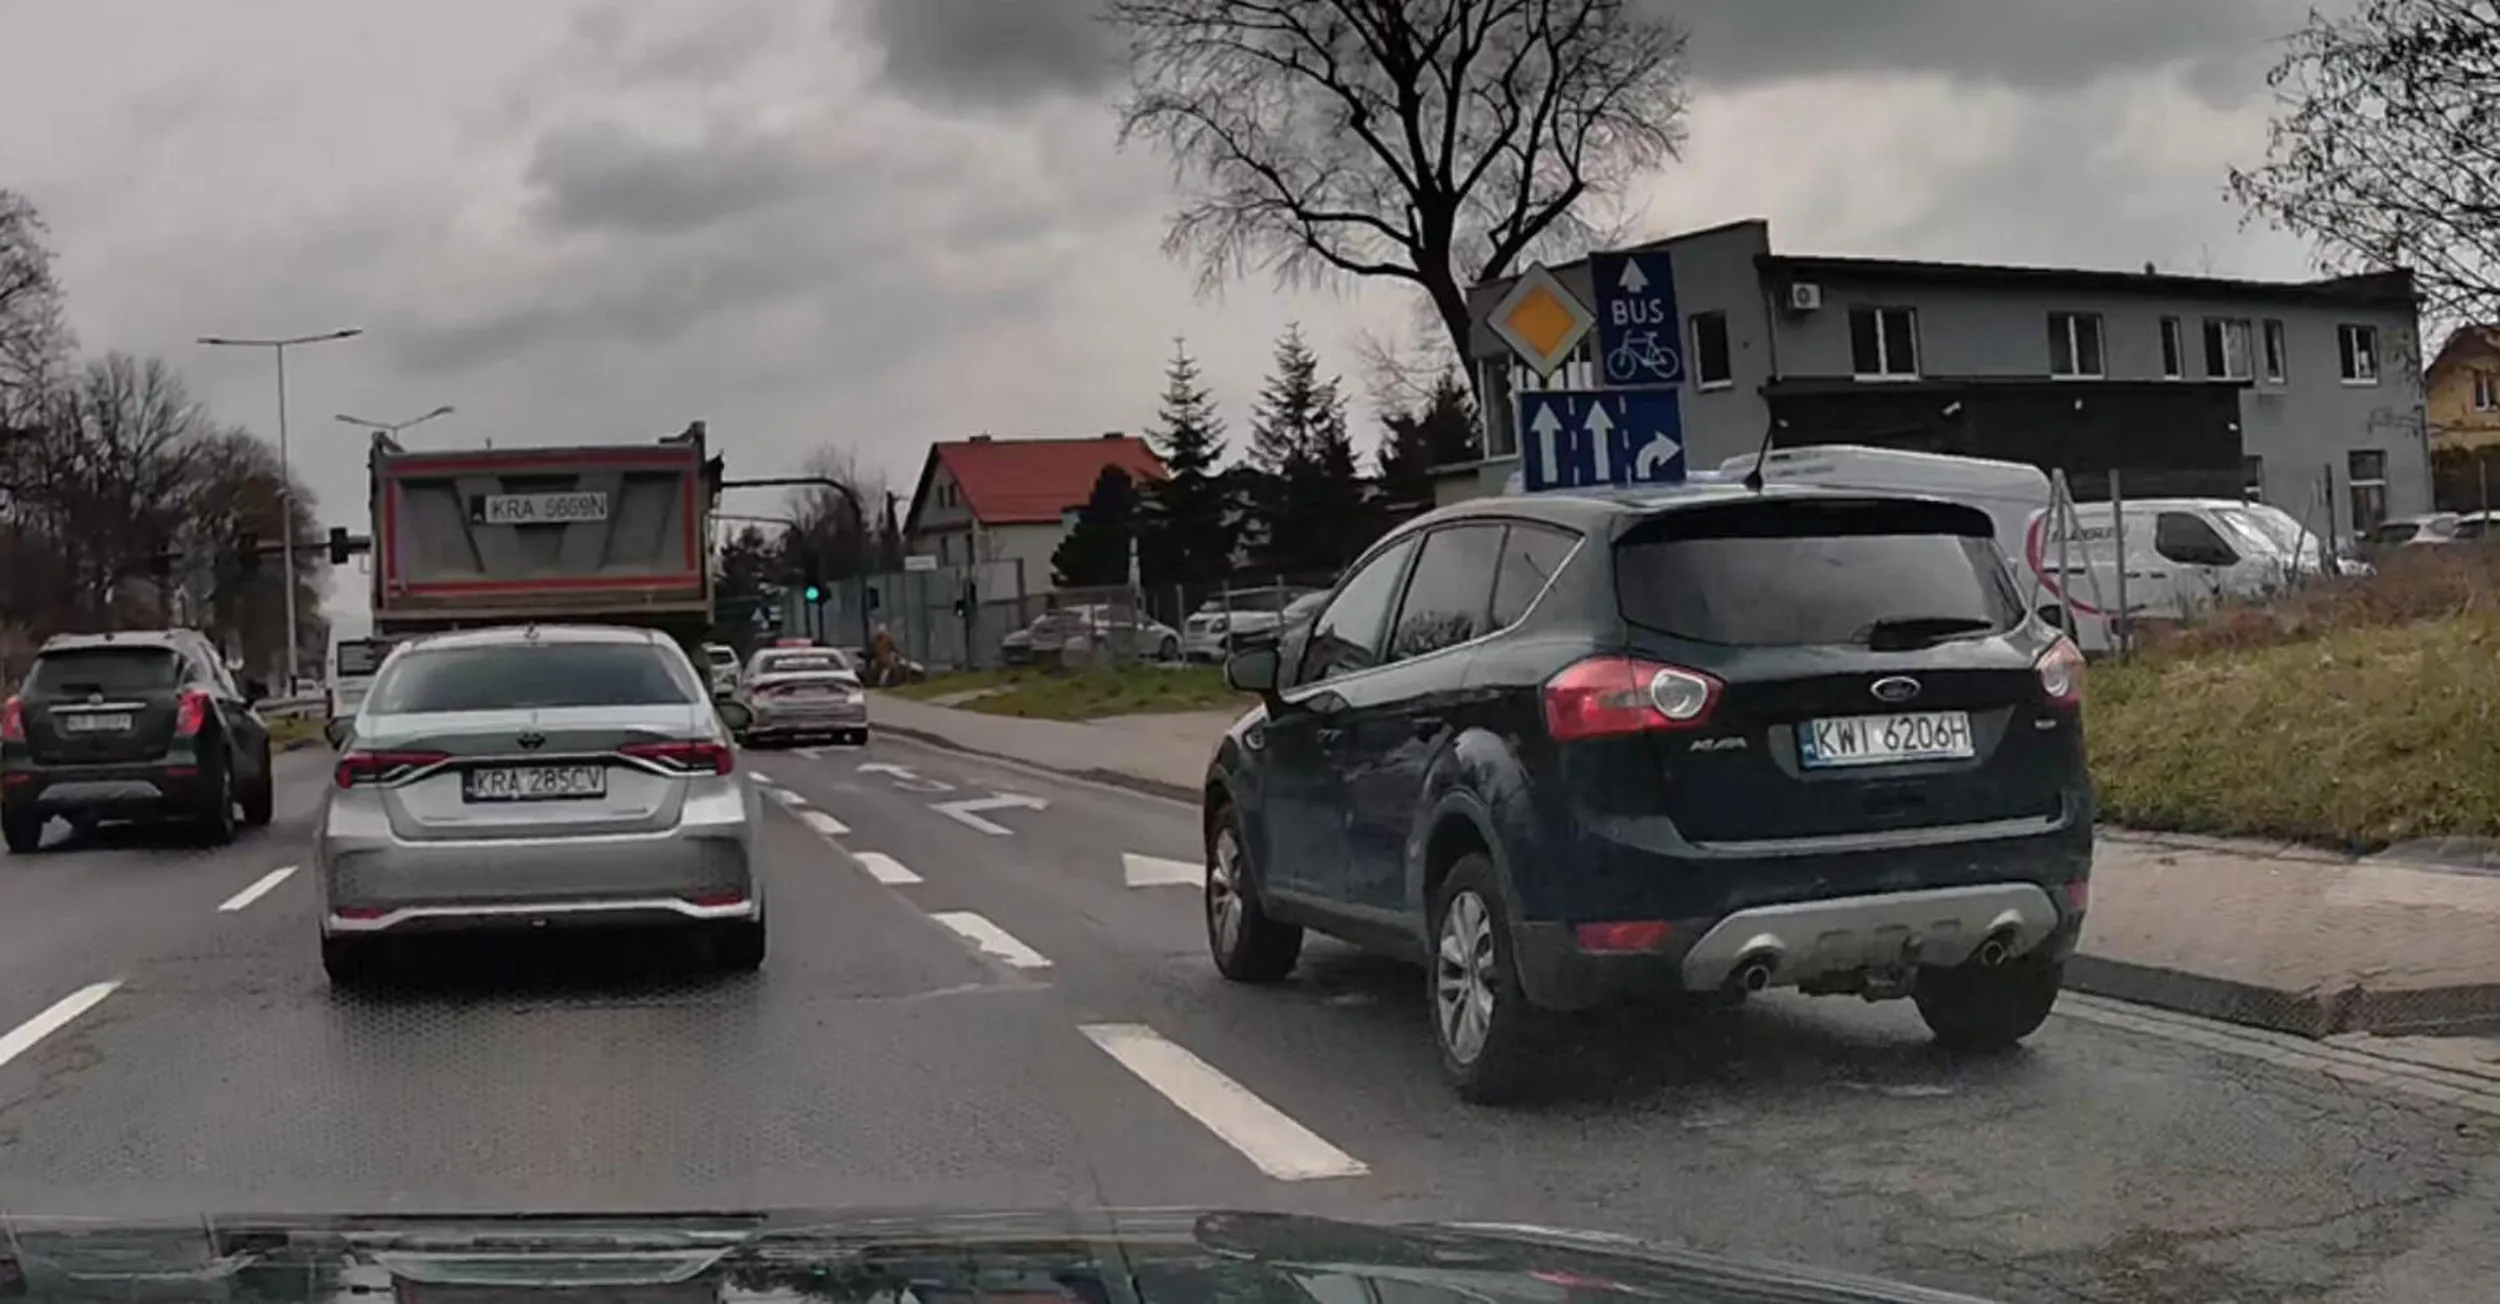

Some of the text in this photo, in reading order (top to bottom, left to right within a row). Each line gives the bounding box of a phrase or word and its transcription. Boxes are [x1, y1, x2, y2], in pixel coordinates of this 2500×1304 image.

[1611, 298, 1664, 325] BUS
[492, 498, 535, 519] KRA
[1816, 713, 1968, 755] KWI 6206H
[476, 767, 600, 793] KRA 285CV
